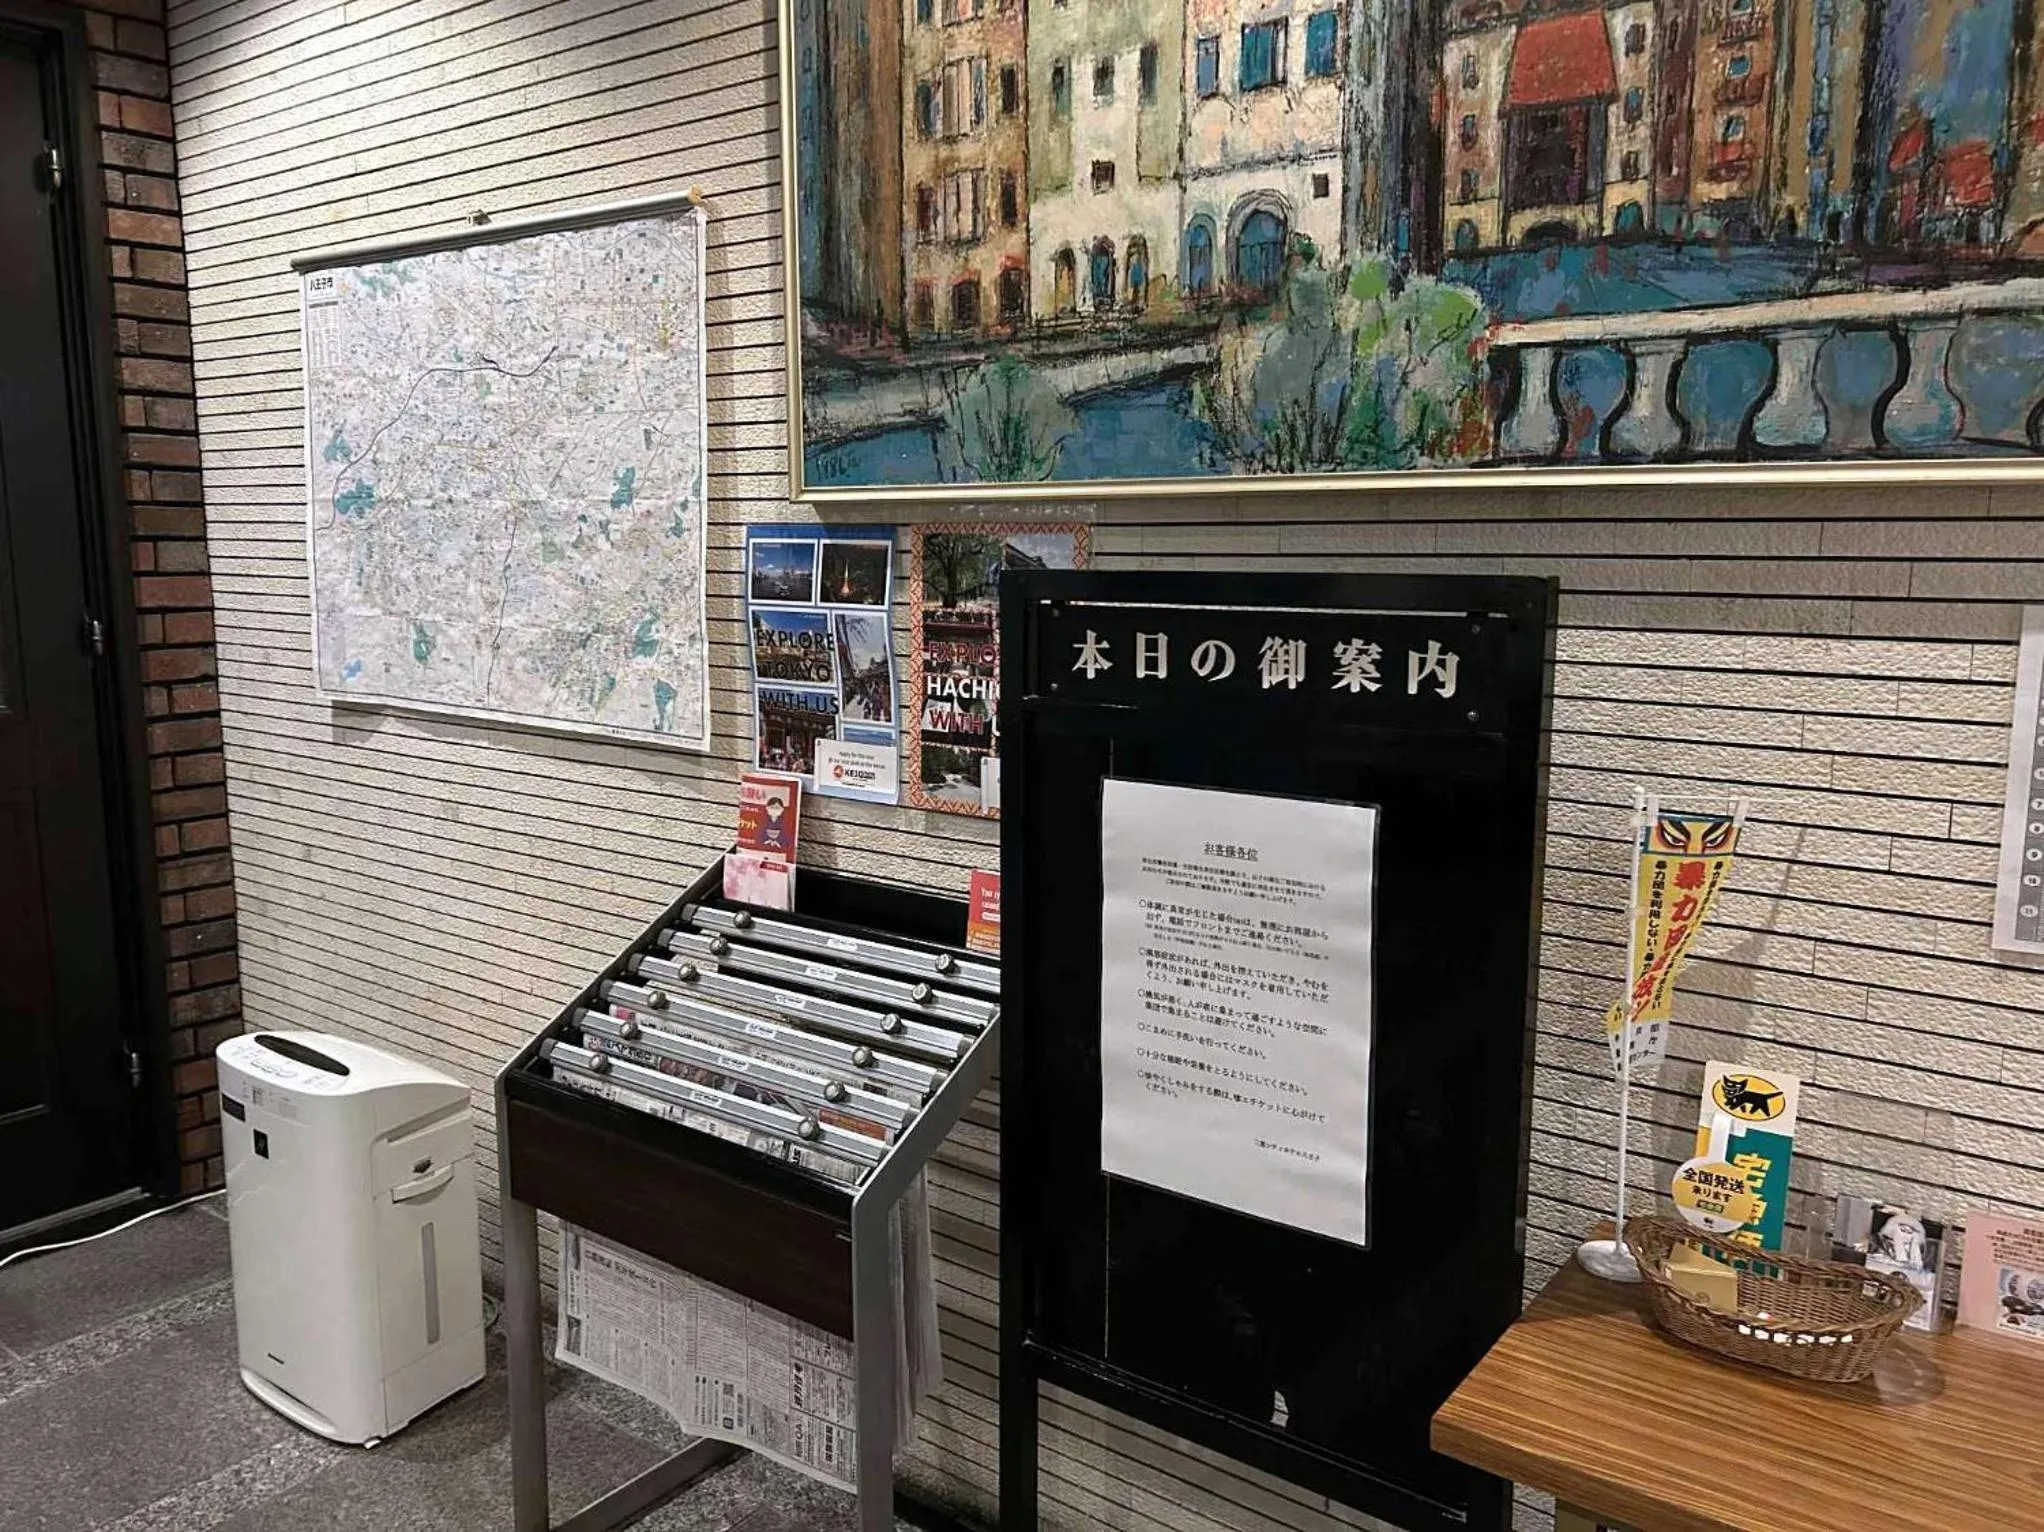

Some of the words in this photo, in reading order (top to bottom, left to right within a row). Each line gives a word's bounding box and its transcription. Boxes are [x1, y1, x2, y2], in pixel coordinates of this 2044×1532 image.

[755, 629, 836, 652] EXPLORE
[764, 660, 831, 683] TOKYO
[1071, 629, 1461, 699] 本日の御案内
[926, 675, 1000, 700] HACHI
[763, 690, 811, 712] WITH
[815, 695, 840, 715] US
[929, 707, 985, 736] WITH
[1682, 1167, 1745, 1195] 全国発送
[1691, 1185, 1733, 1203] 承ります
